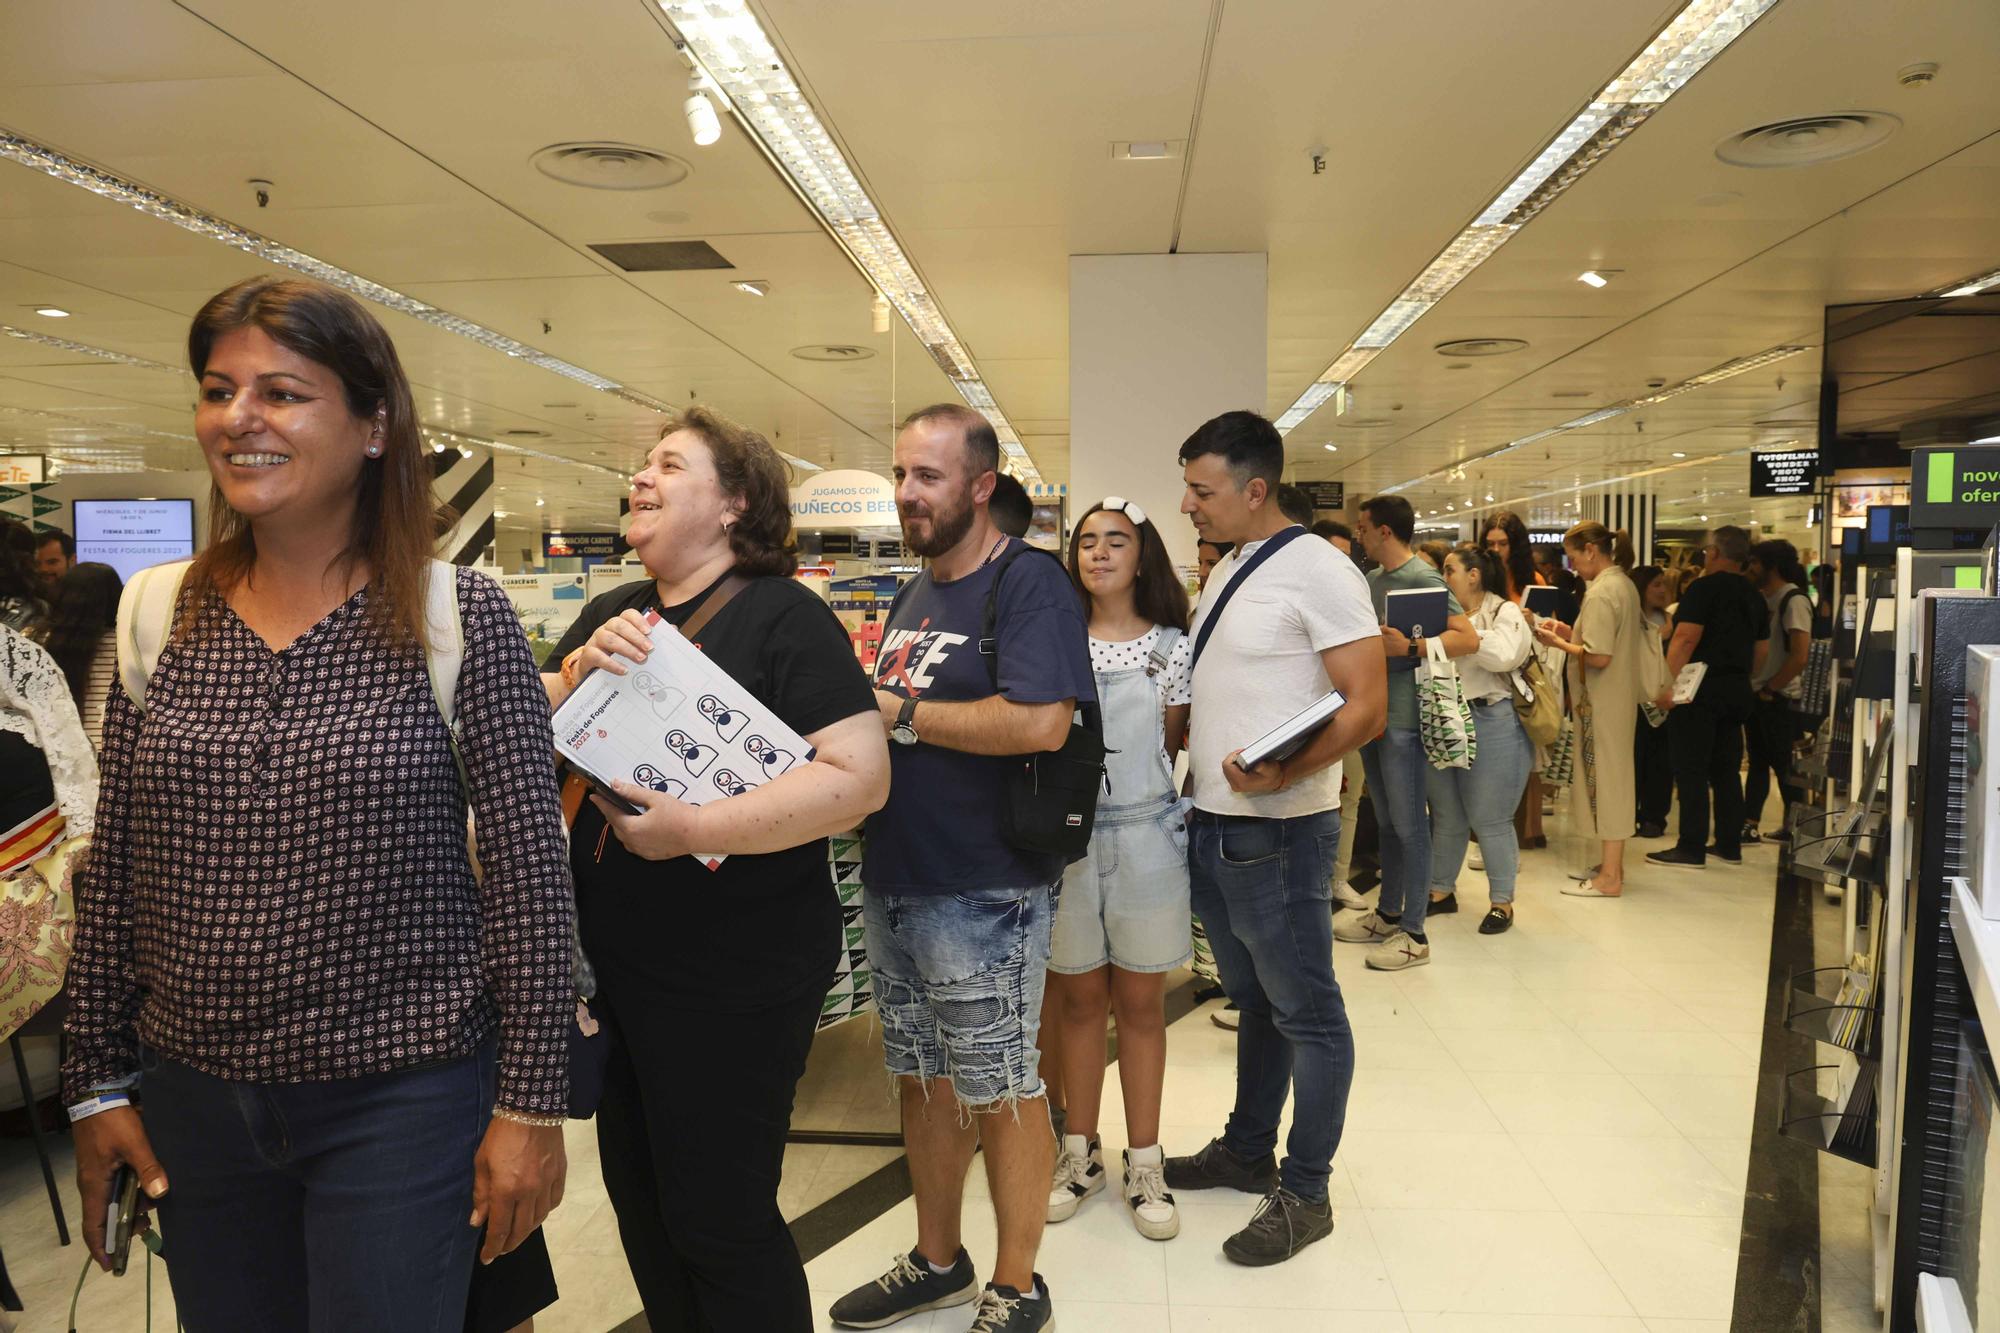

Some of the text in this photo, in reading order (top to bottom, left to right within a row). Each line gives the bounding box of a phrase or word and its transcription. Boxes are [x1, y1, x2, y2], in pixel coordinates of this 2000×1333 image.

[1962, 471, 2000, 483] nov
[811, 487, 880, 496] JUGAMOS CON
[590, 536, 614, 544] CARNET
[566, 689, 620, 746] Festa de Fogueres
[572, 731, 591, 750] 2023
